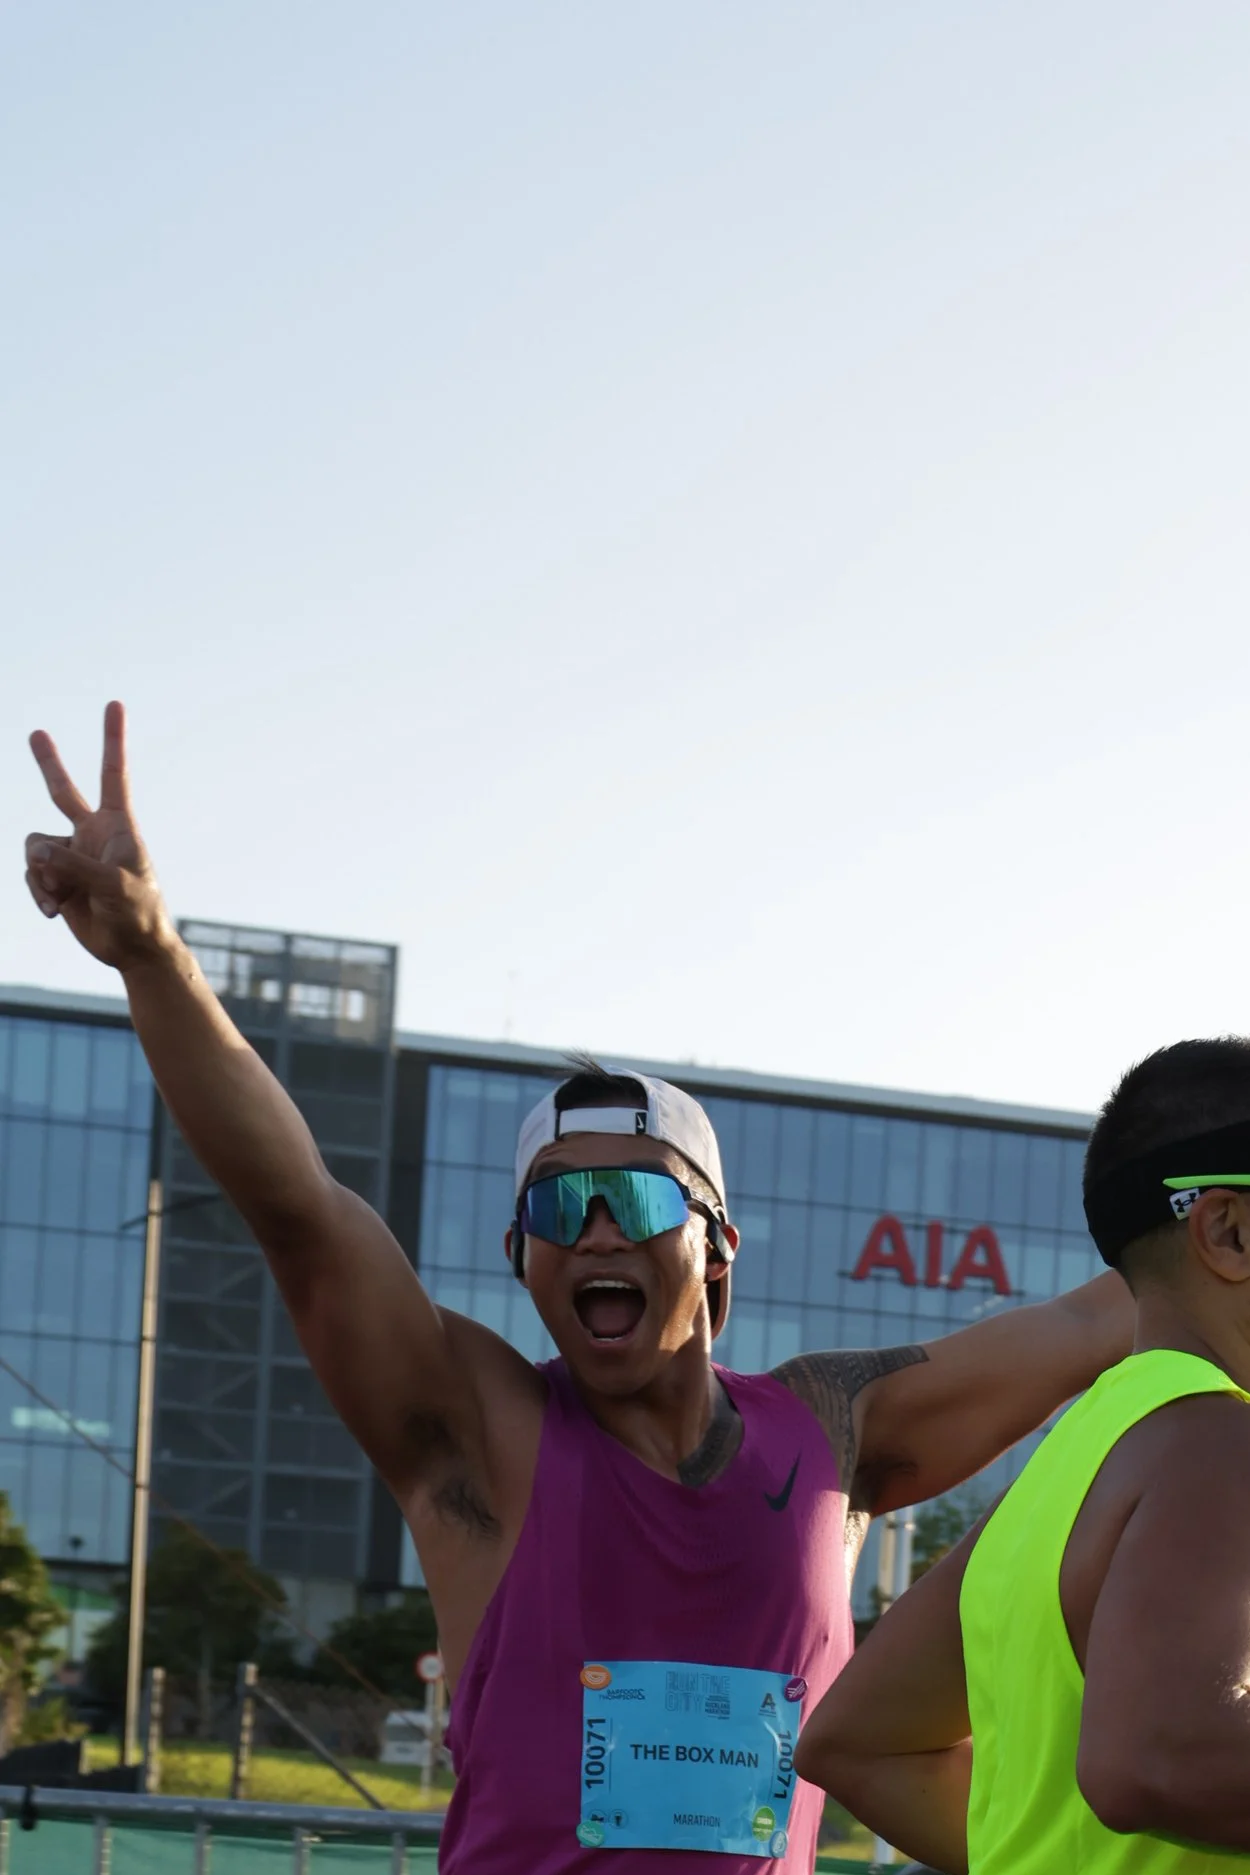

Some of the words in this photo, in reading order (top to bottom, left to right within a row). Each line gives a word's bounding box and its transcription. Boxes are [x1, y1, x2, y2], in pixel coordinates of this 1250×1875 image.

[851, 1213, 1011, 1295] AIA
[585, 1717, 606, 1789] 10071
[630, 1744, 670, 1761] THE
[675, 1747, 715, 1763] BOX
[720, 1750, 759, 1768] MAN
[774, 1730, 793, 1799] 10071
[673, 1813, 721, 1828] MARATHON
